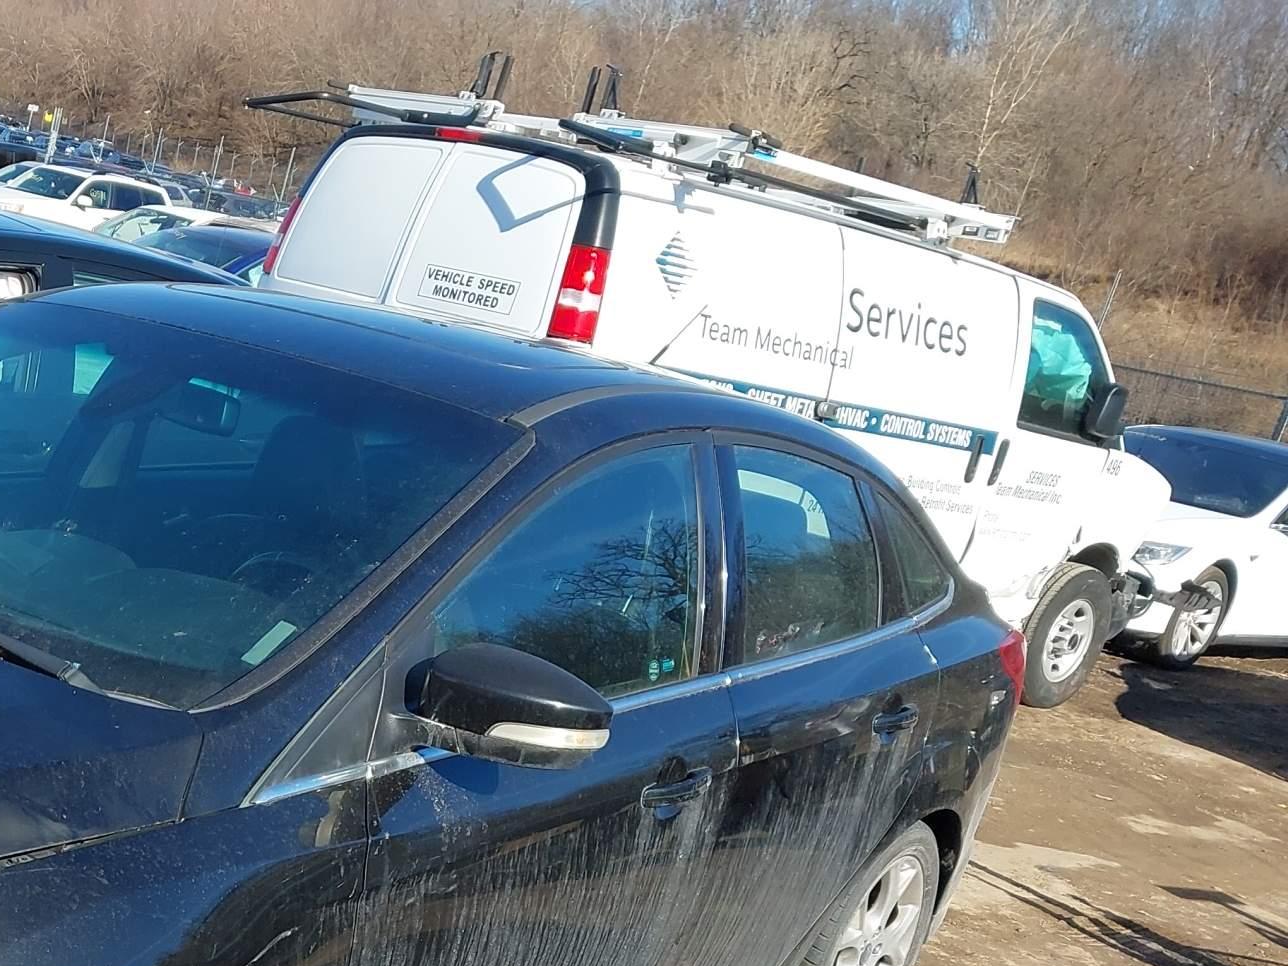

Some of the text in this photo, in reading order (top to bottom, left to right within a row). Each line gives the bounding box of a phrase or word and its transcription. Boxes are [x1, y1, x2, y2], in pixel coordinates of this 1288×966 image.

[428, 267, 516, 296] VEHICLE SPEED
[431, 284, 499, 309] MONITORED
[846, 287, 968, 357] Services
[700, 313, 854, 370] Team Mechanical
[838, 406, 870, 429] HVAC
[879, 413, 926, 439] CONTROL
[927, 422, 973, 449] SYSTEMS
[1025, 470, 1061, 488] SERVICES
[1106, 459, 1124, 477] 496
